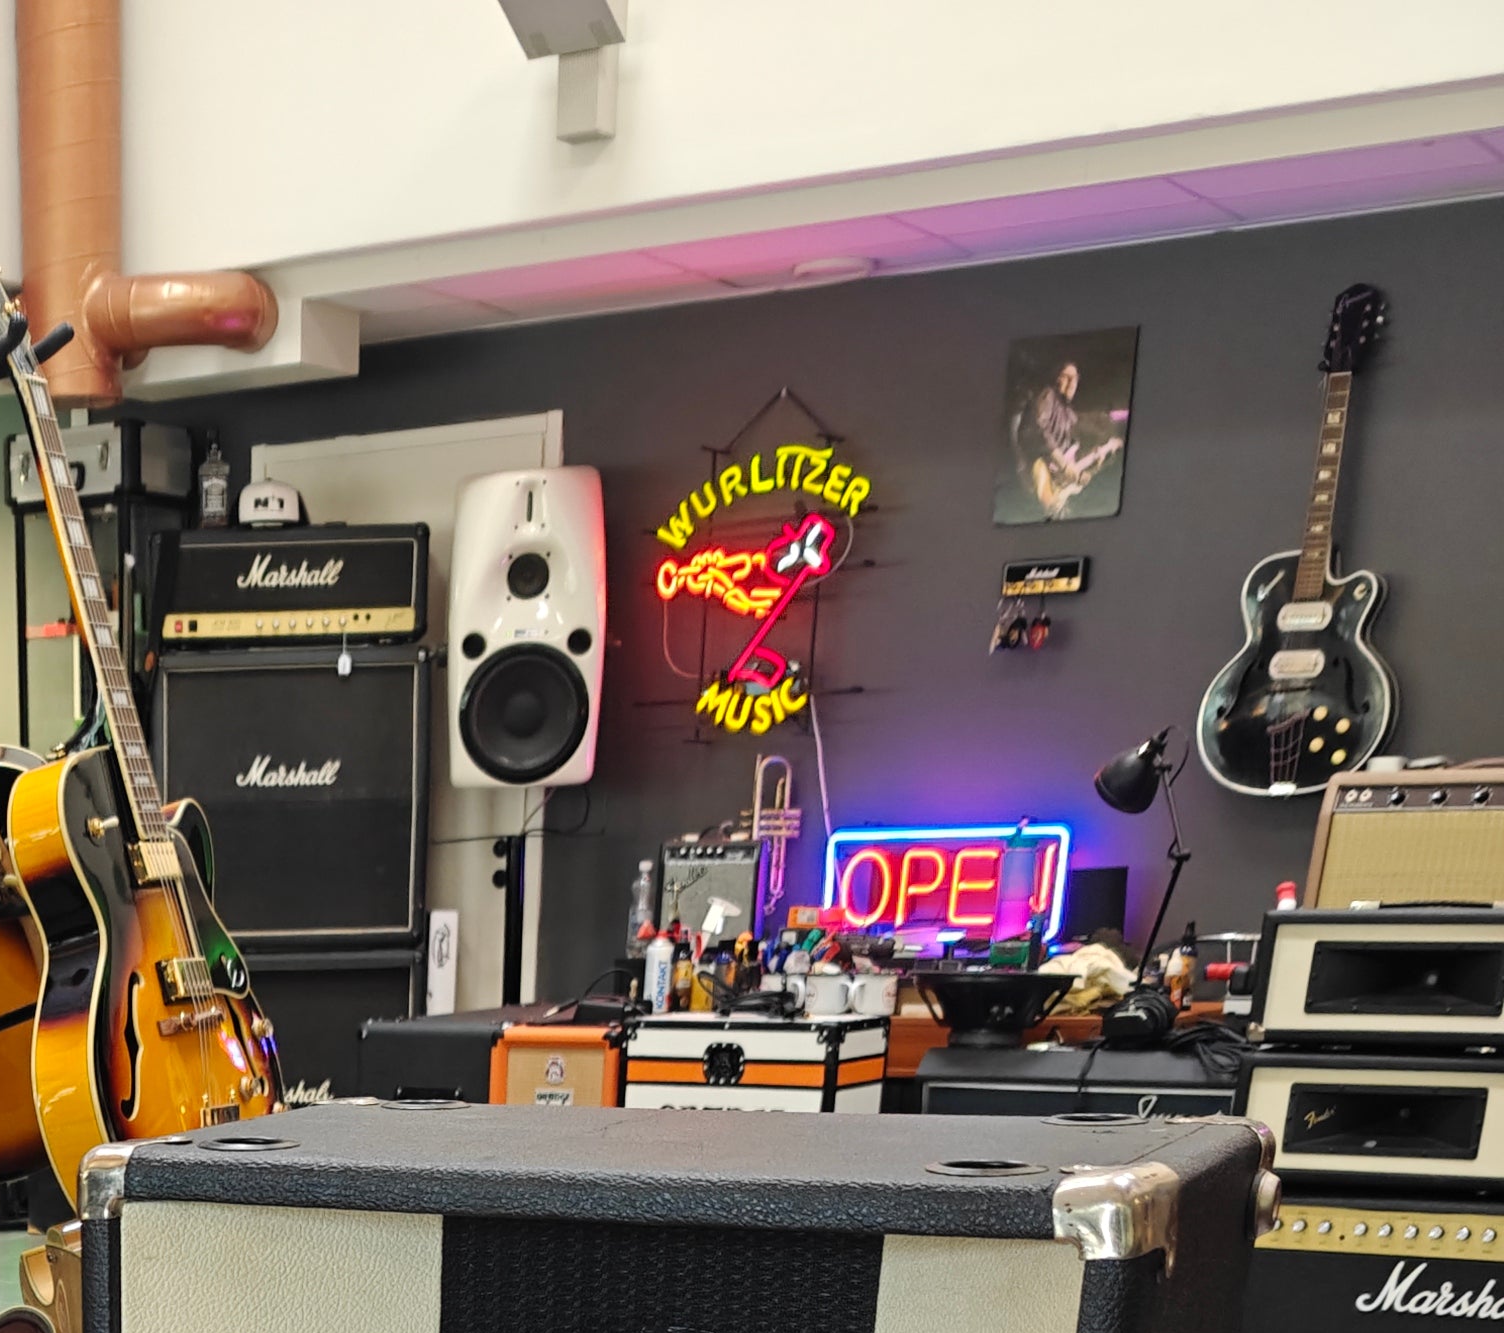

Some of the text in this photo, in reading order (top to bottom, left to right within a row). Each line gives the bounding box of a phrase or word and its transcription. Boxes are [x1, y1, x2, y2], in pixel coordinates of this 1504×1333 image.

[657, 444, 872, 550] WURLITZER
[236, 552, 344, 588] Marshall
[695, 676, 810, 736] MUSIC
[235, 754, 342, 788] Marshall
[655, 960, 671, 1011] KONTAKT
